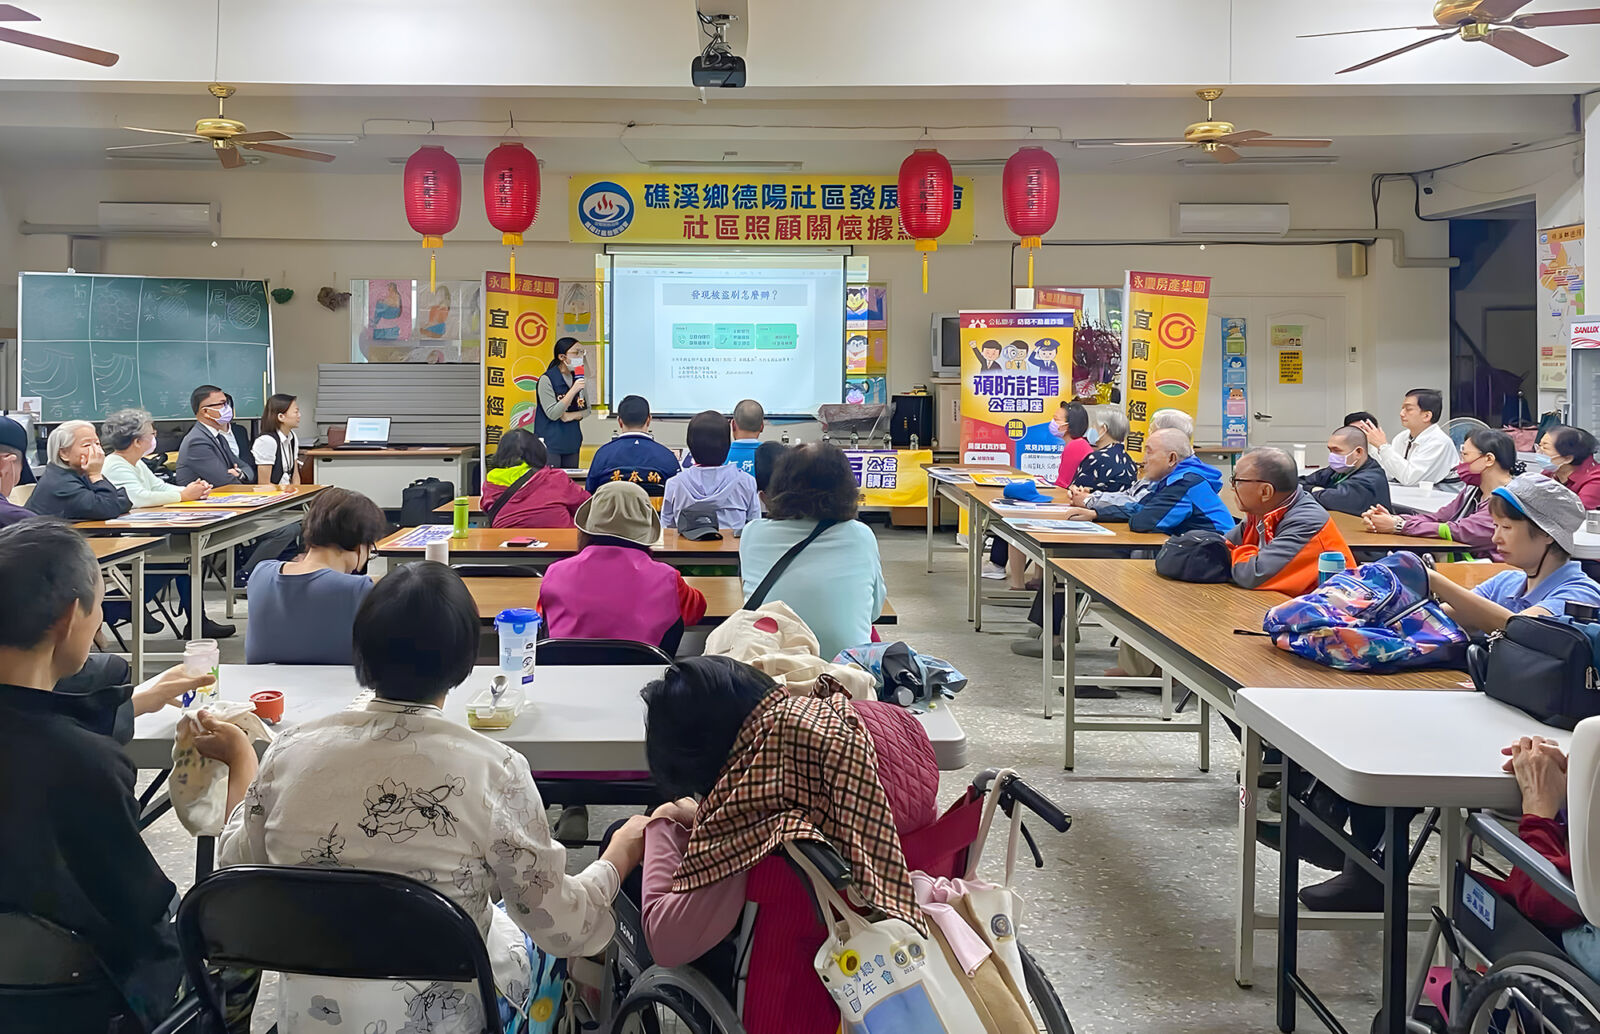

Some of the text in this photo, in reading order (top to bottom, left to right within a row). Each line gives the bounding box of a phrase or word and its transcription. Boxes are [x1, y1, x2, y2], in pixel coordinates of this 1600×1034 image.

[644, 184, 964, 210] 礁溪鄉德陽社區發展
[1574, 326, 1600, 334] SANLUX
[485, 308, 509, 468] 宜蘭區經管
[973, 375, 1059, 396] 預防詐騙
[1126, 308, 1153, 469] 宜蘭區經管
[989, 397, 1043, 413] 公益講座
[867, 456, 897, 472] 公益
[866, 473, 897, 489] 講座
